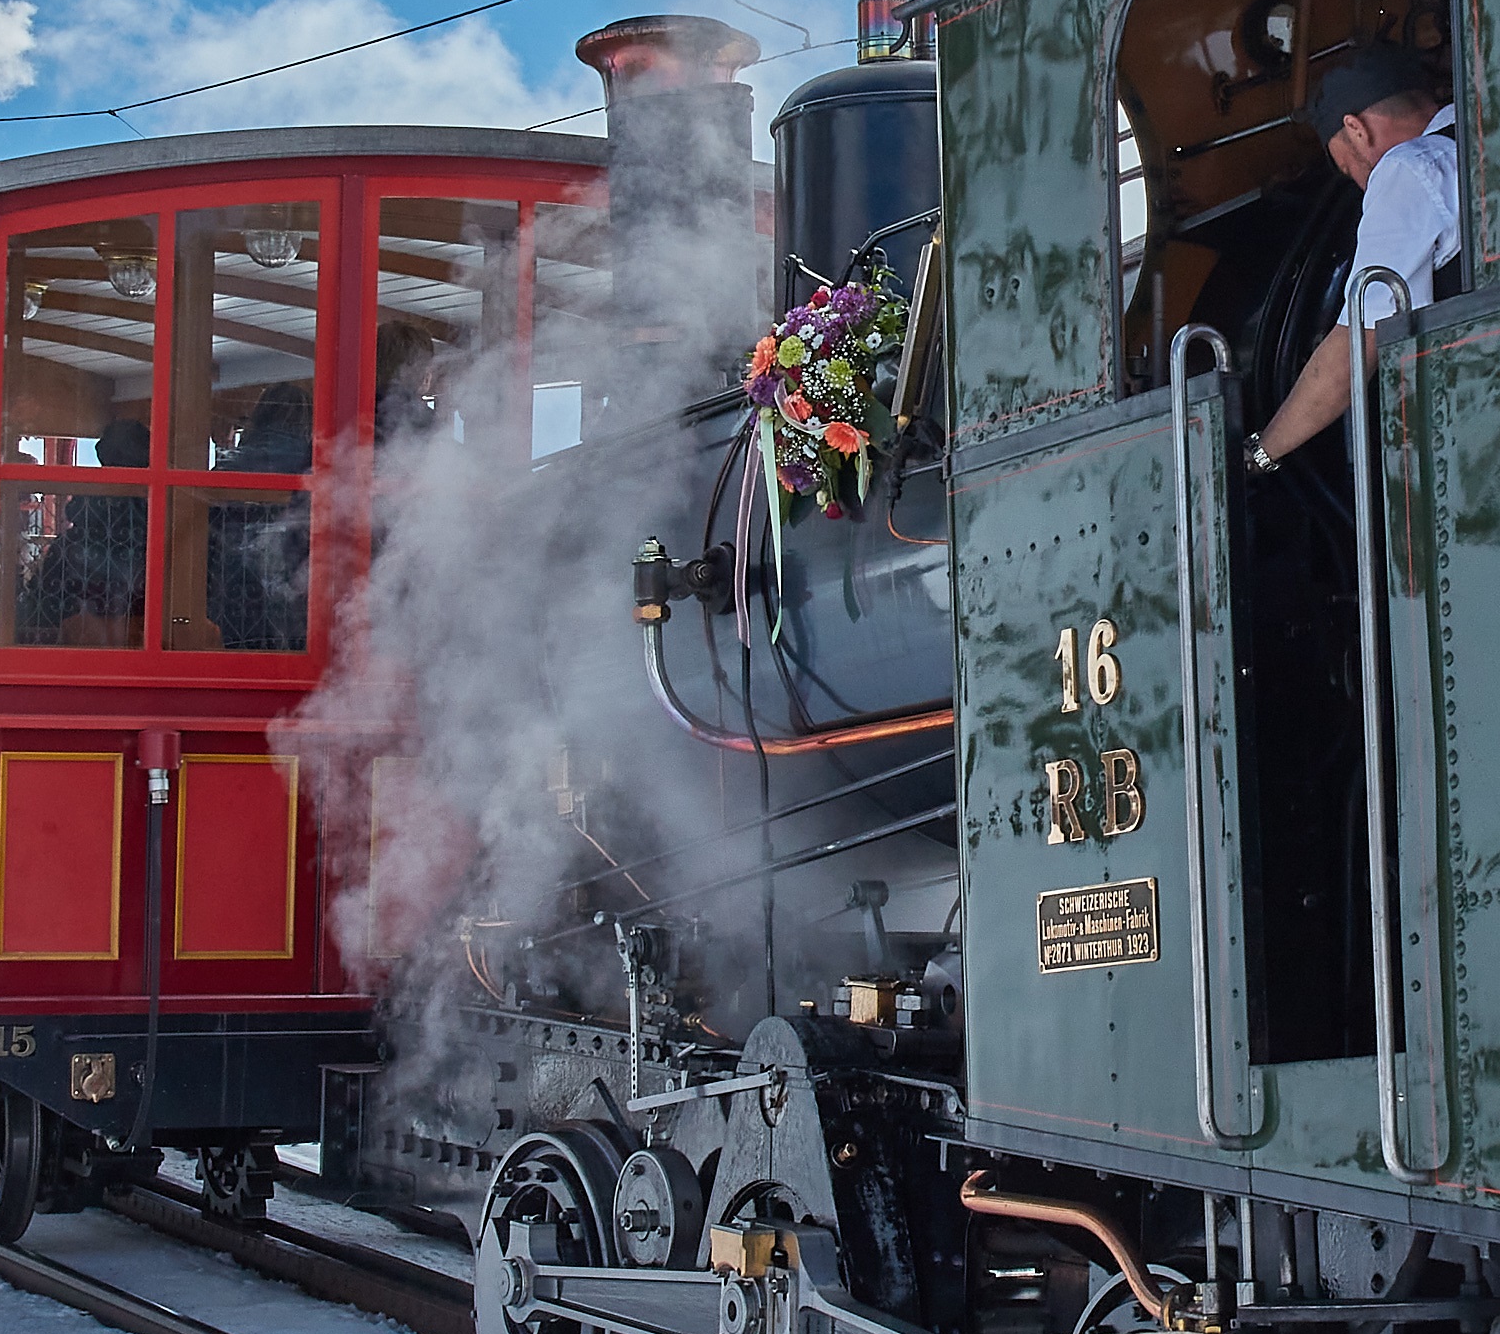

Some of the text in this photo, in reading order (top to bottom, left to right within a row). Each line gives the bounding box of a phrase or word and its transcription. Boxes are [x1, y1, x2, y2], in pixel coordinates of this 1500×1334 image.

[1054, 618, 1121, 714] 16
[1059, 889, 1130, 915] SCHWEIZERISCHE
[1074, 938, 1123, 961] WINTERTHUR
[1126, 932, 1149, 956] 1923
